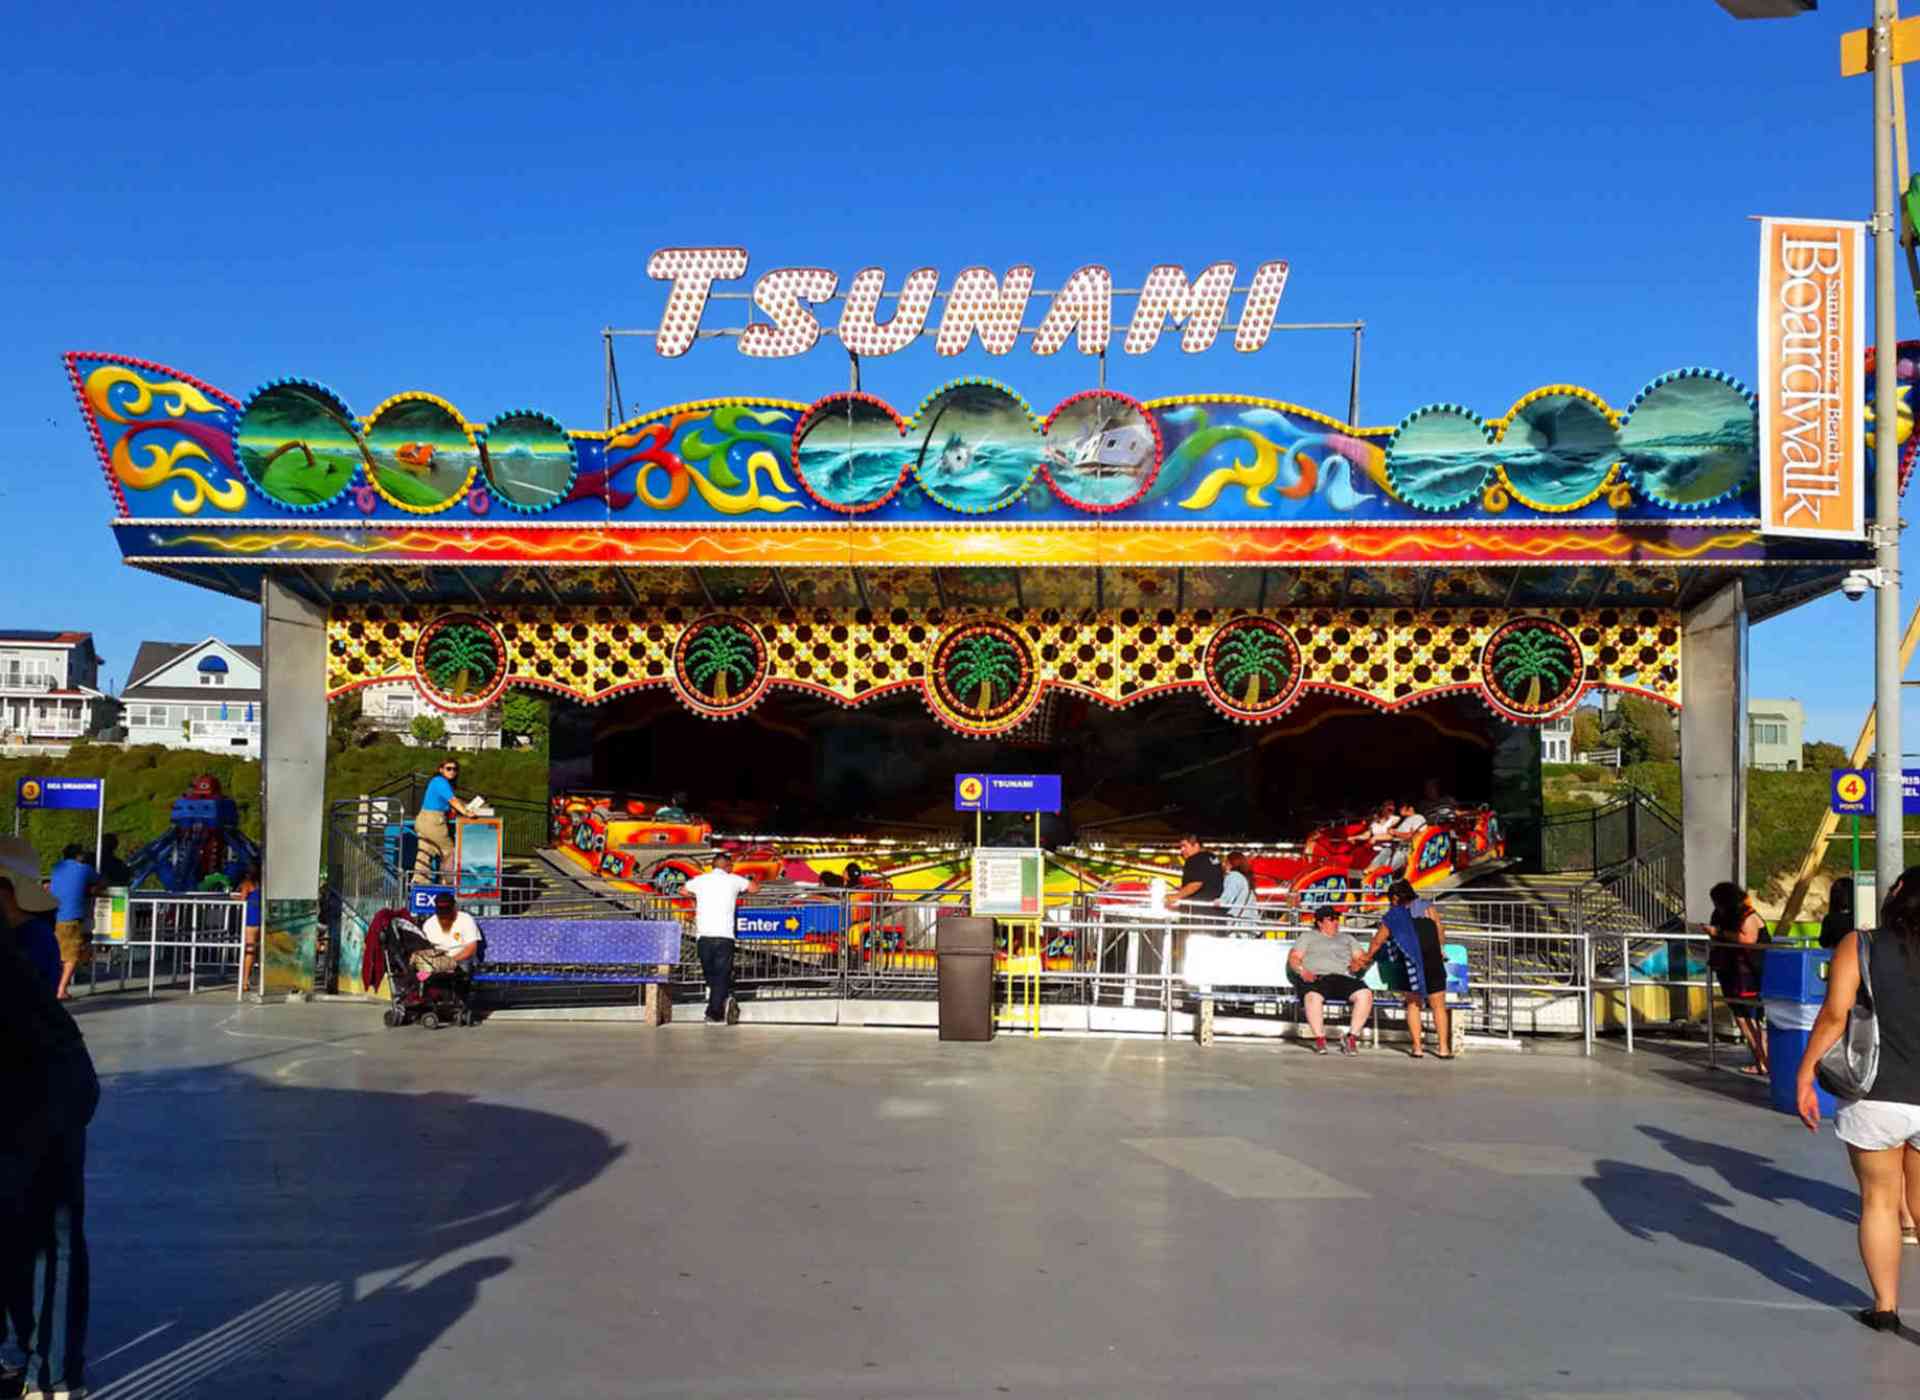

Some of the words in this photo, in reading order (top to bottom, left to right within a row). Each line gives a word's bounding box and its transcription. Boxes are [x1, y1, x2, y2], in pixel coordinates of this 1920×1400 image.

[646, 248, 1288, 357] TSUNAMI
[1826, 336, 1842, 384] Cruz
[1780, 231, 1842, 526] Boardwalk
[965, 782, 977, 795] 4
[1844, 780, 1858, 796] 4
[415, 892, 437, 907] Ex
[736, 917, 780, 932] Enter
